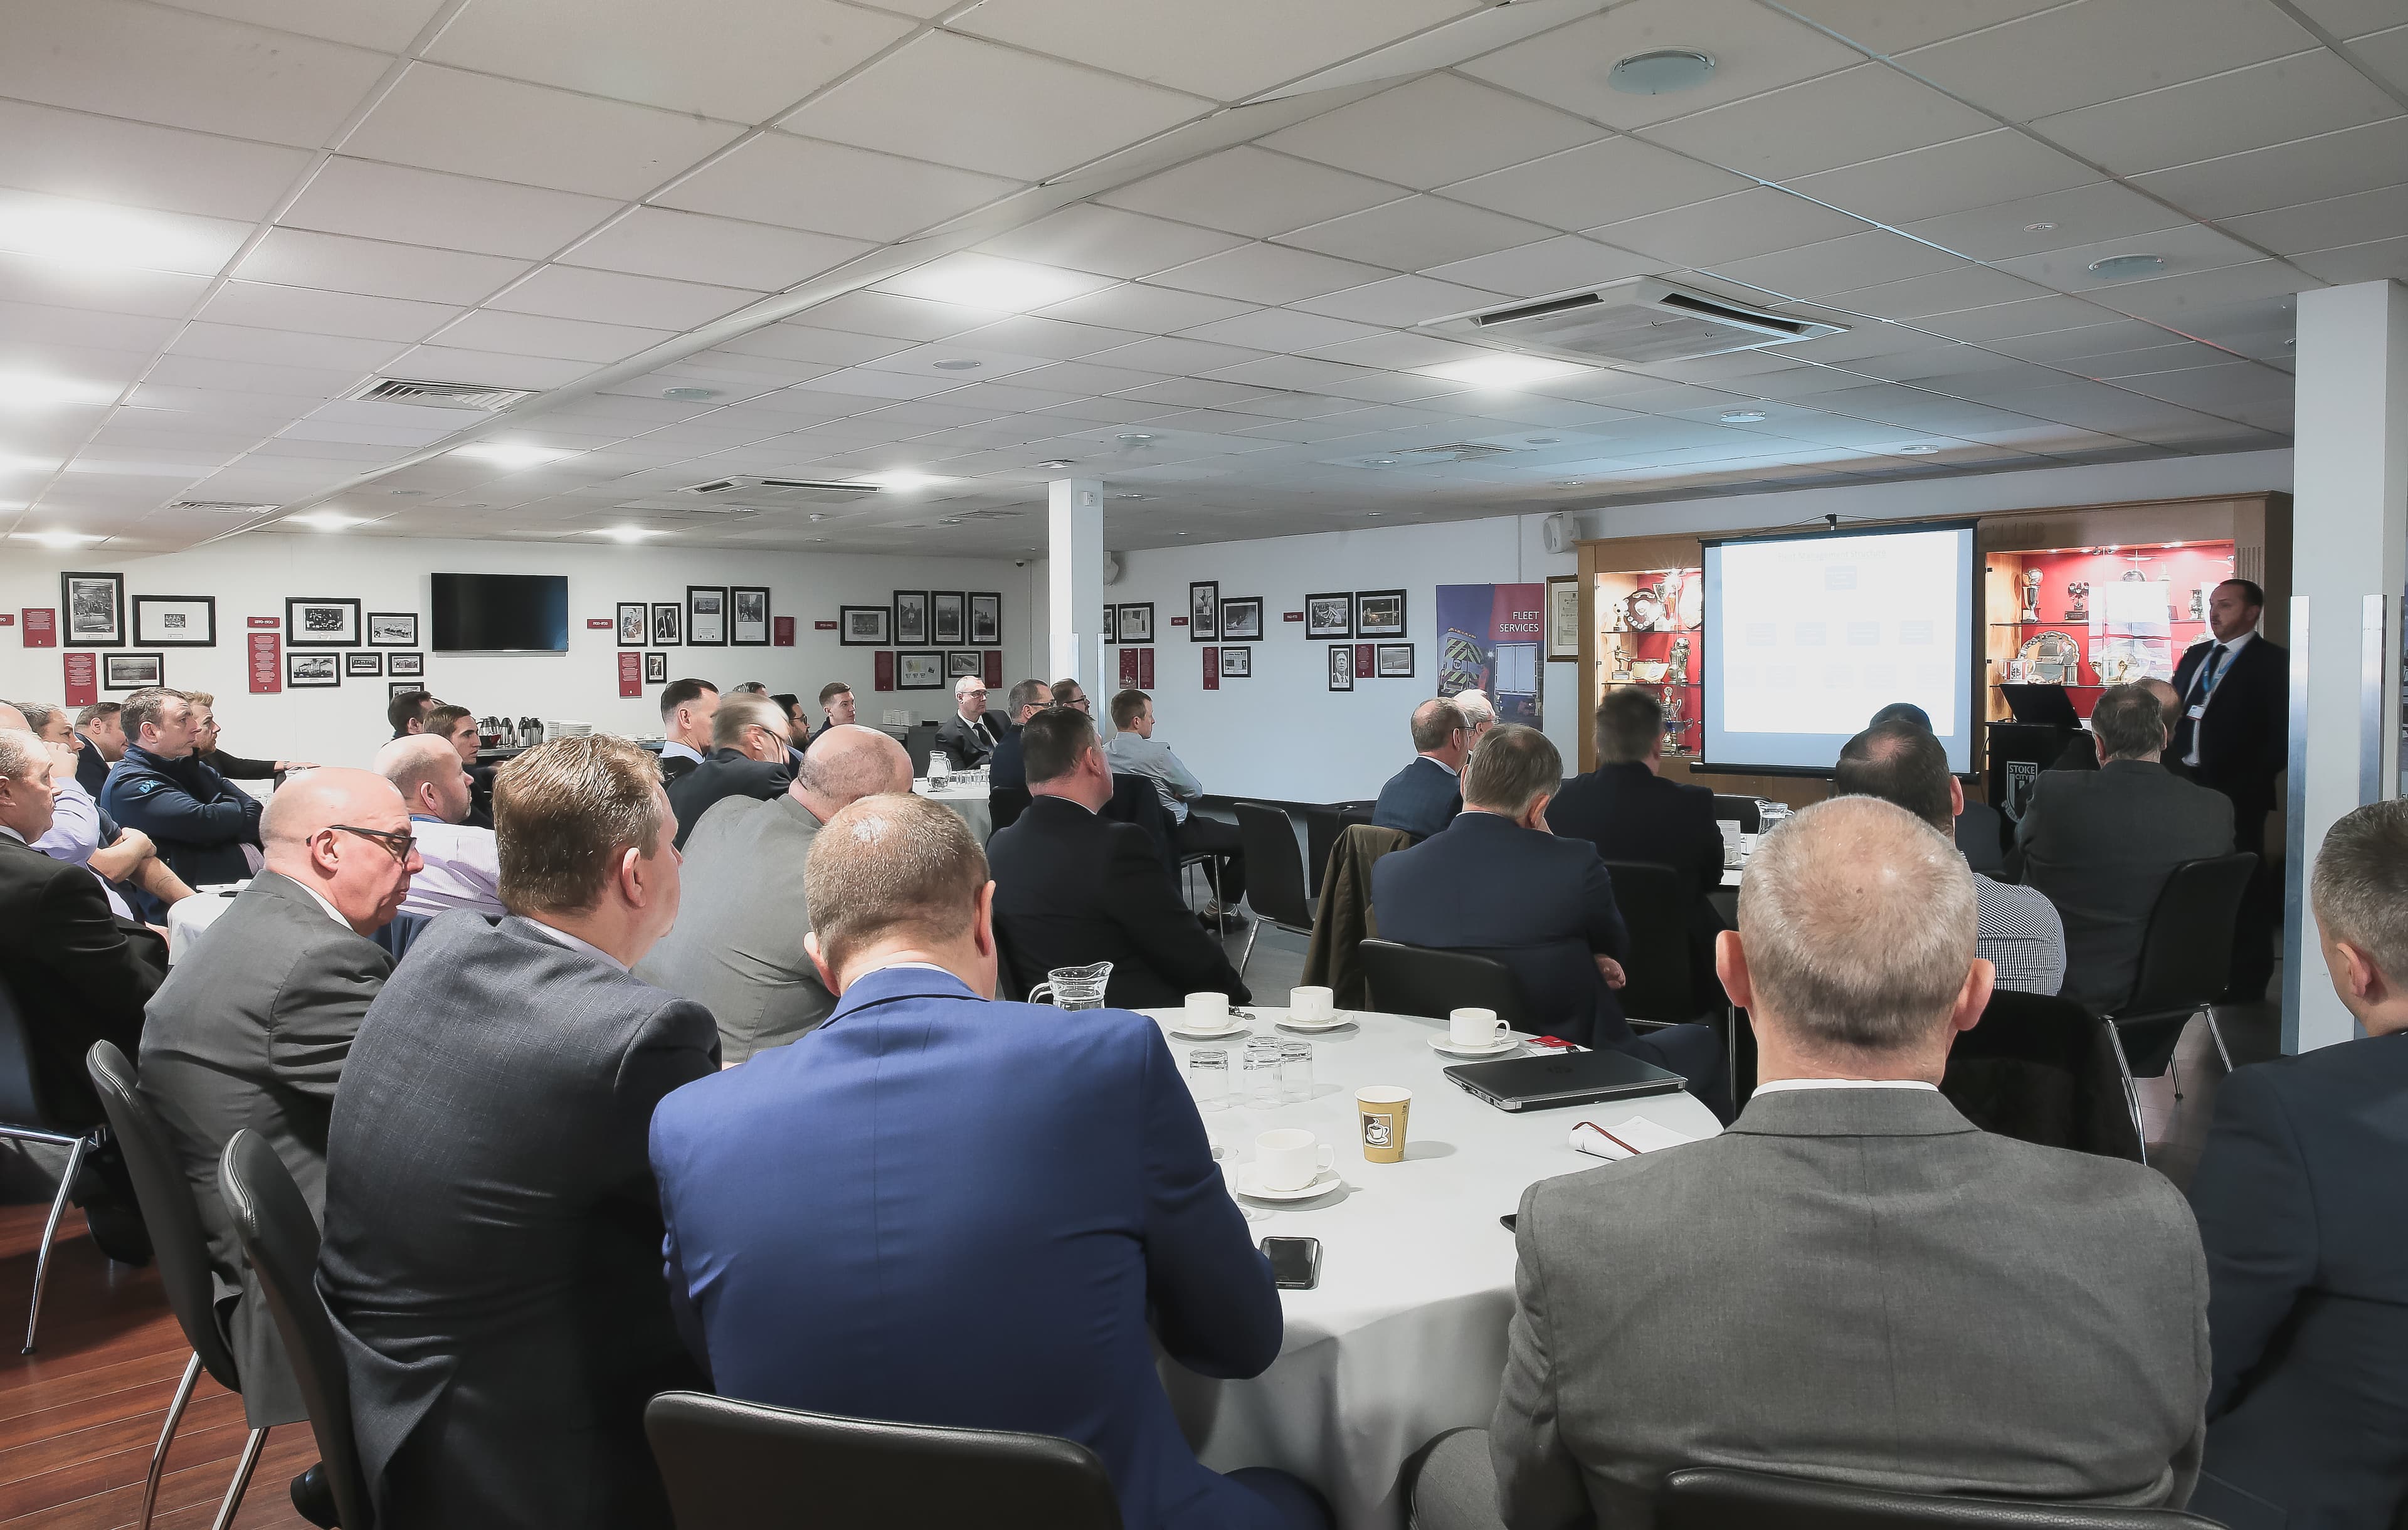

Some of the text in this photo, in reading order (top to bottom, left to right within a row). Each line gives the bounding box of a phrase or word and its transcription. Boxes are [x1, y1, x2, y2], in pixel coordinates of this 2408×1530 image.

[1513, 611, 1540, 620] FLEET
[1499, 623, 1539, 632] SERVICES
[2009, 765, 2036, 774] STOKE
